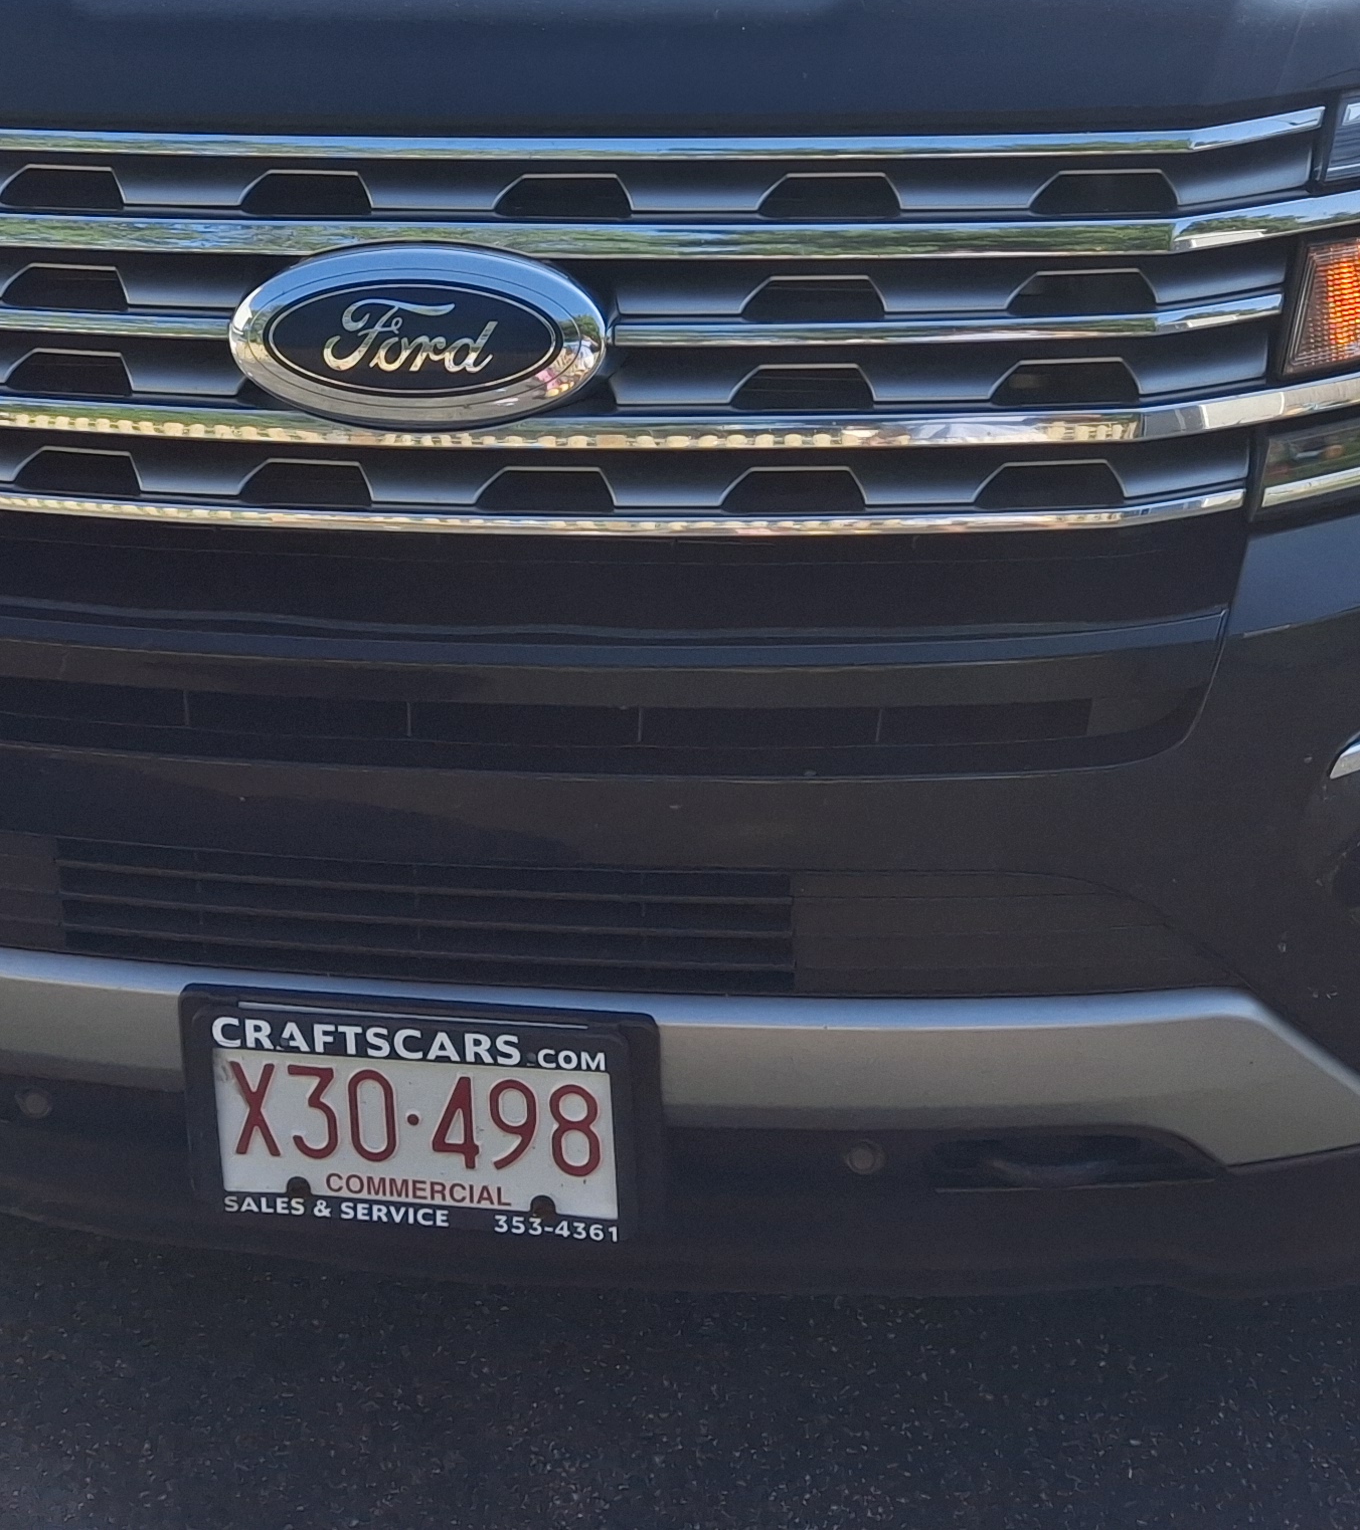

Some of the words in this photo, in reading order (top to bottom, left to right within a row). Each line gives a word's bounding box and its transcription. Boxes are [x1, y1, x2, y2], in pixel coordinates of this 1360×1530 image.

[323, 298, 499, 373] Ford
[325, 1172, 512, 1208] COMMERCIAL
[224, 1196, 305, 1217] SALES
[313, 1199, 332, 1219] &
[340, 1202, 450, 1228] SERVICE
[493, 1214, 619, 1243] 353-4361
